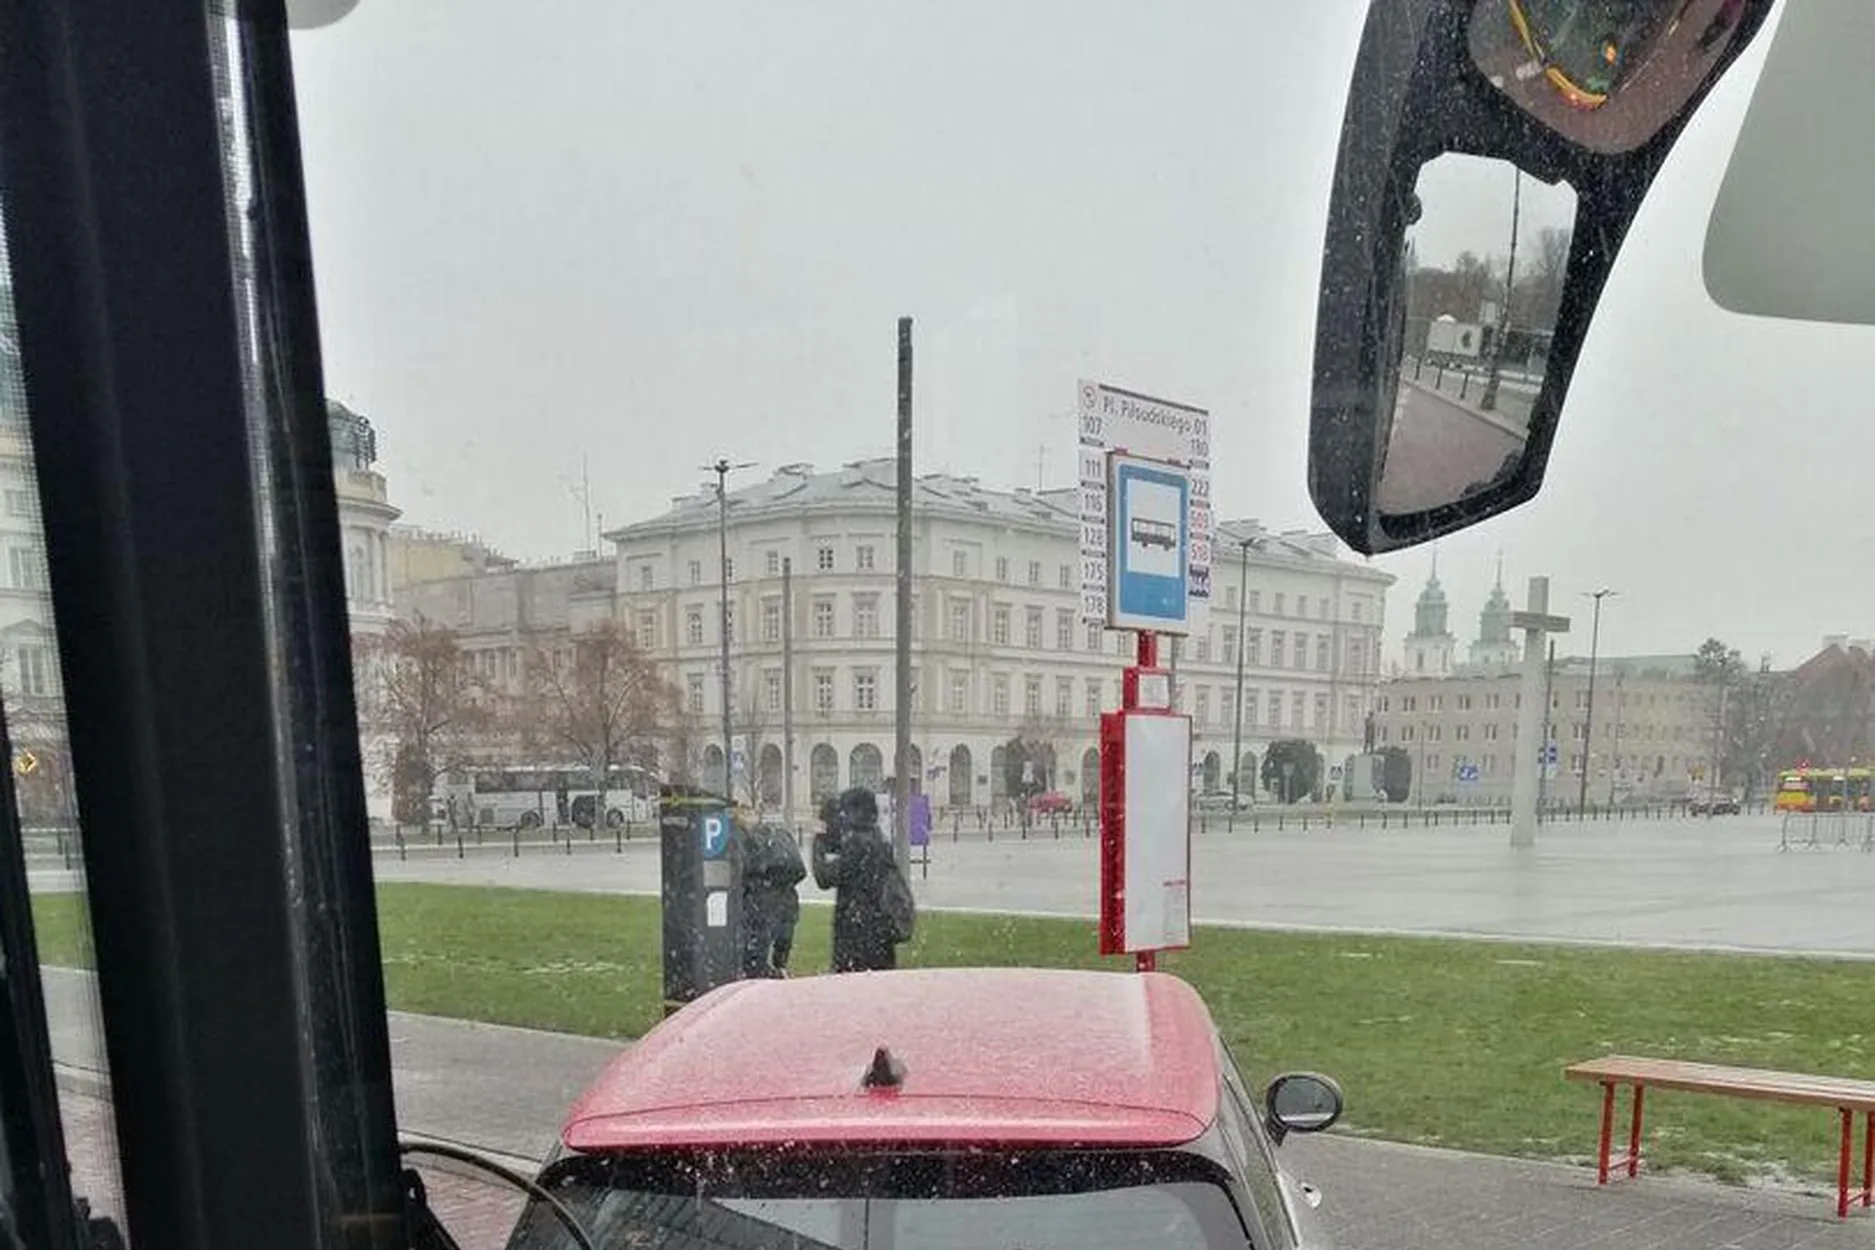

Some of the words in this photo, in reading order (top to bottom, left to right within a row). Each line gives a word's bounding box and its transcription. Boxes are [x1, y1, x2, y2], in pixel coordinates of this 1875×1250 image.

[1083, 414, 1103, 435] 107
[1194, 418, 1208, 436] 01
[1085, 458, 1102, 478] 111
[1191, 477, 1210, 498] 222
[706, 818, 722, 850] P
